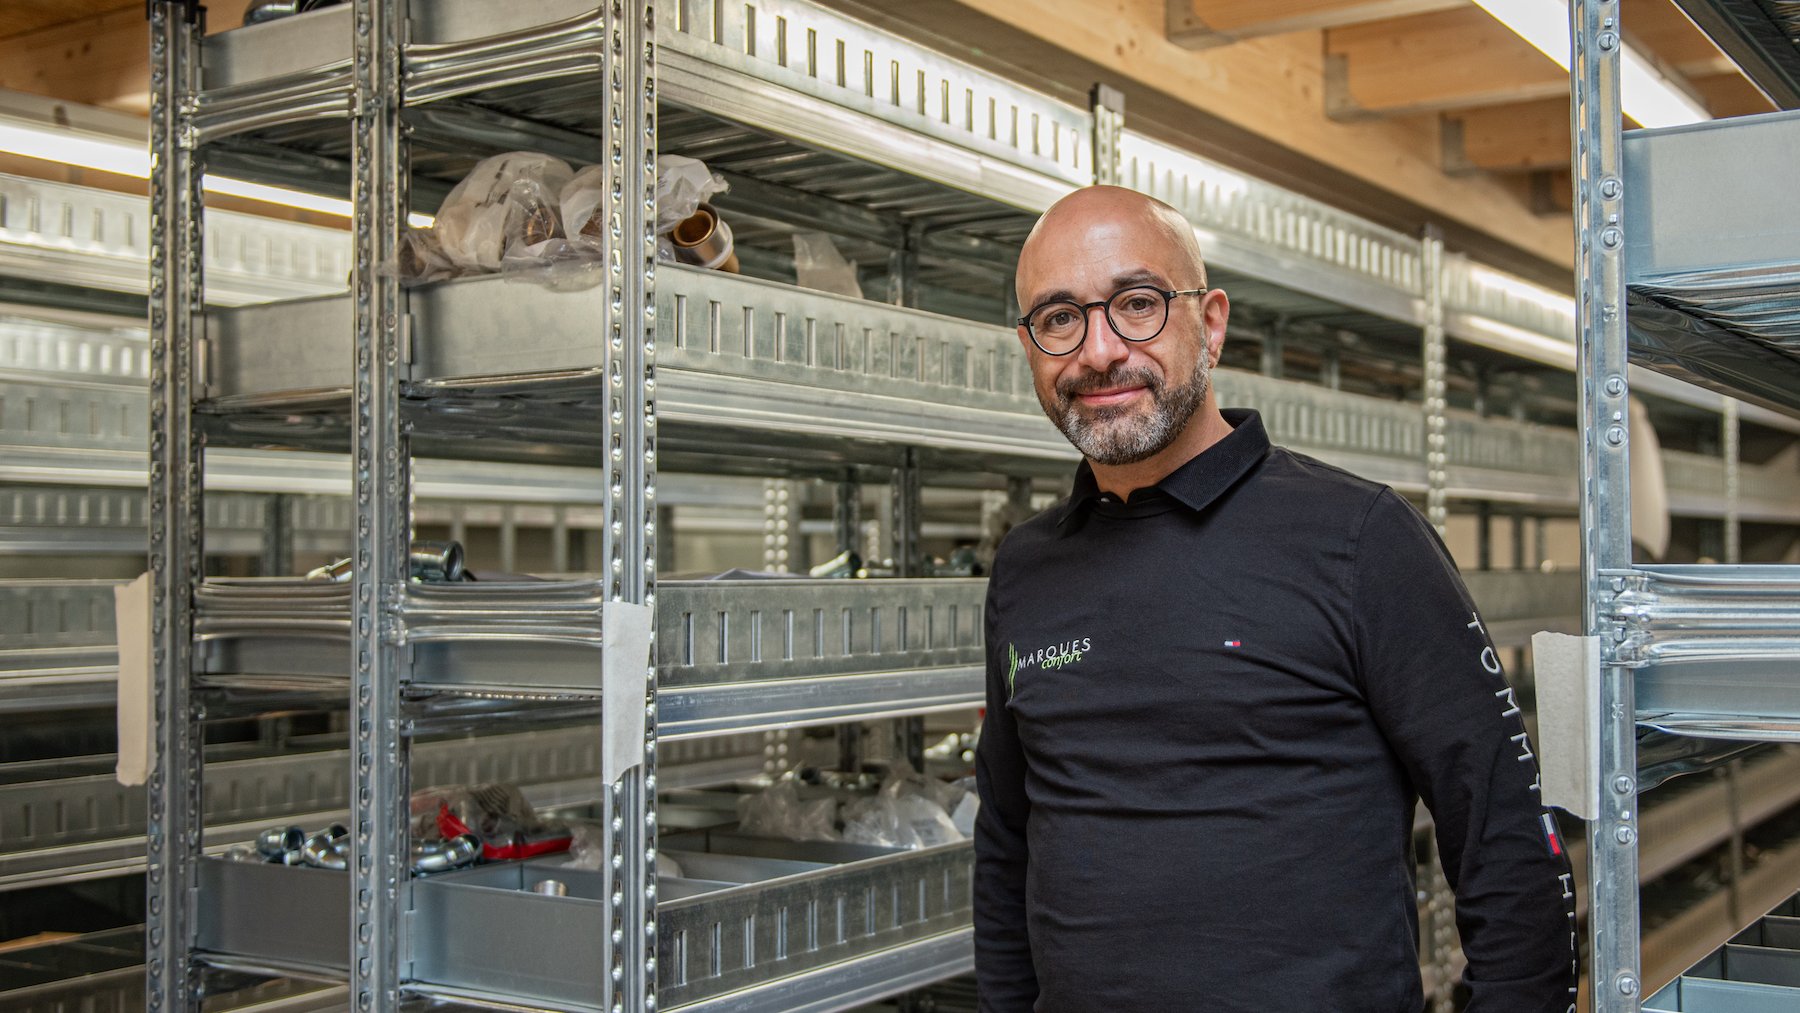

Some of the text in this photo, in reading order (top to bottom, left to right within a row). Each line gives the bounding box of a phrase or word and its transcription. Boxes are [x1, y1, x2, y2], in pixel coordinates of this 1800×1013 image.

[1017, 637, 1092, 672] MARQUES
[1041, 650, 1083, 670] confort
[1467, 611, 1542, 791] TOMMY
